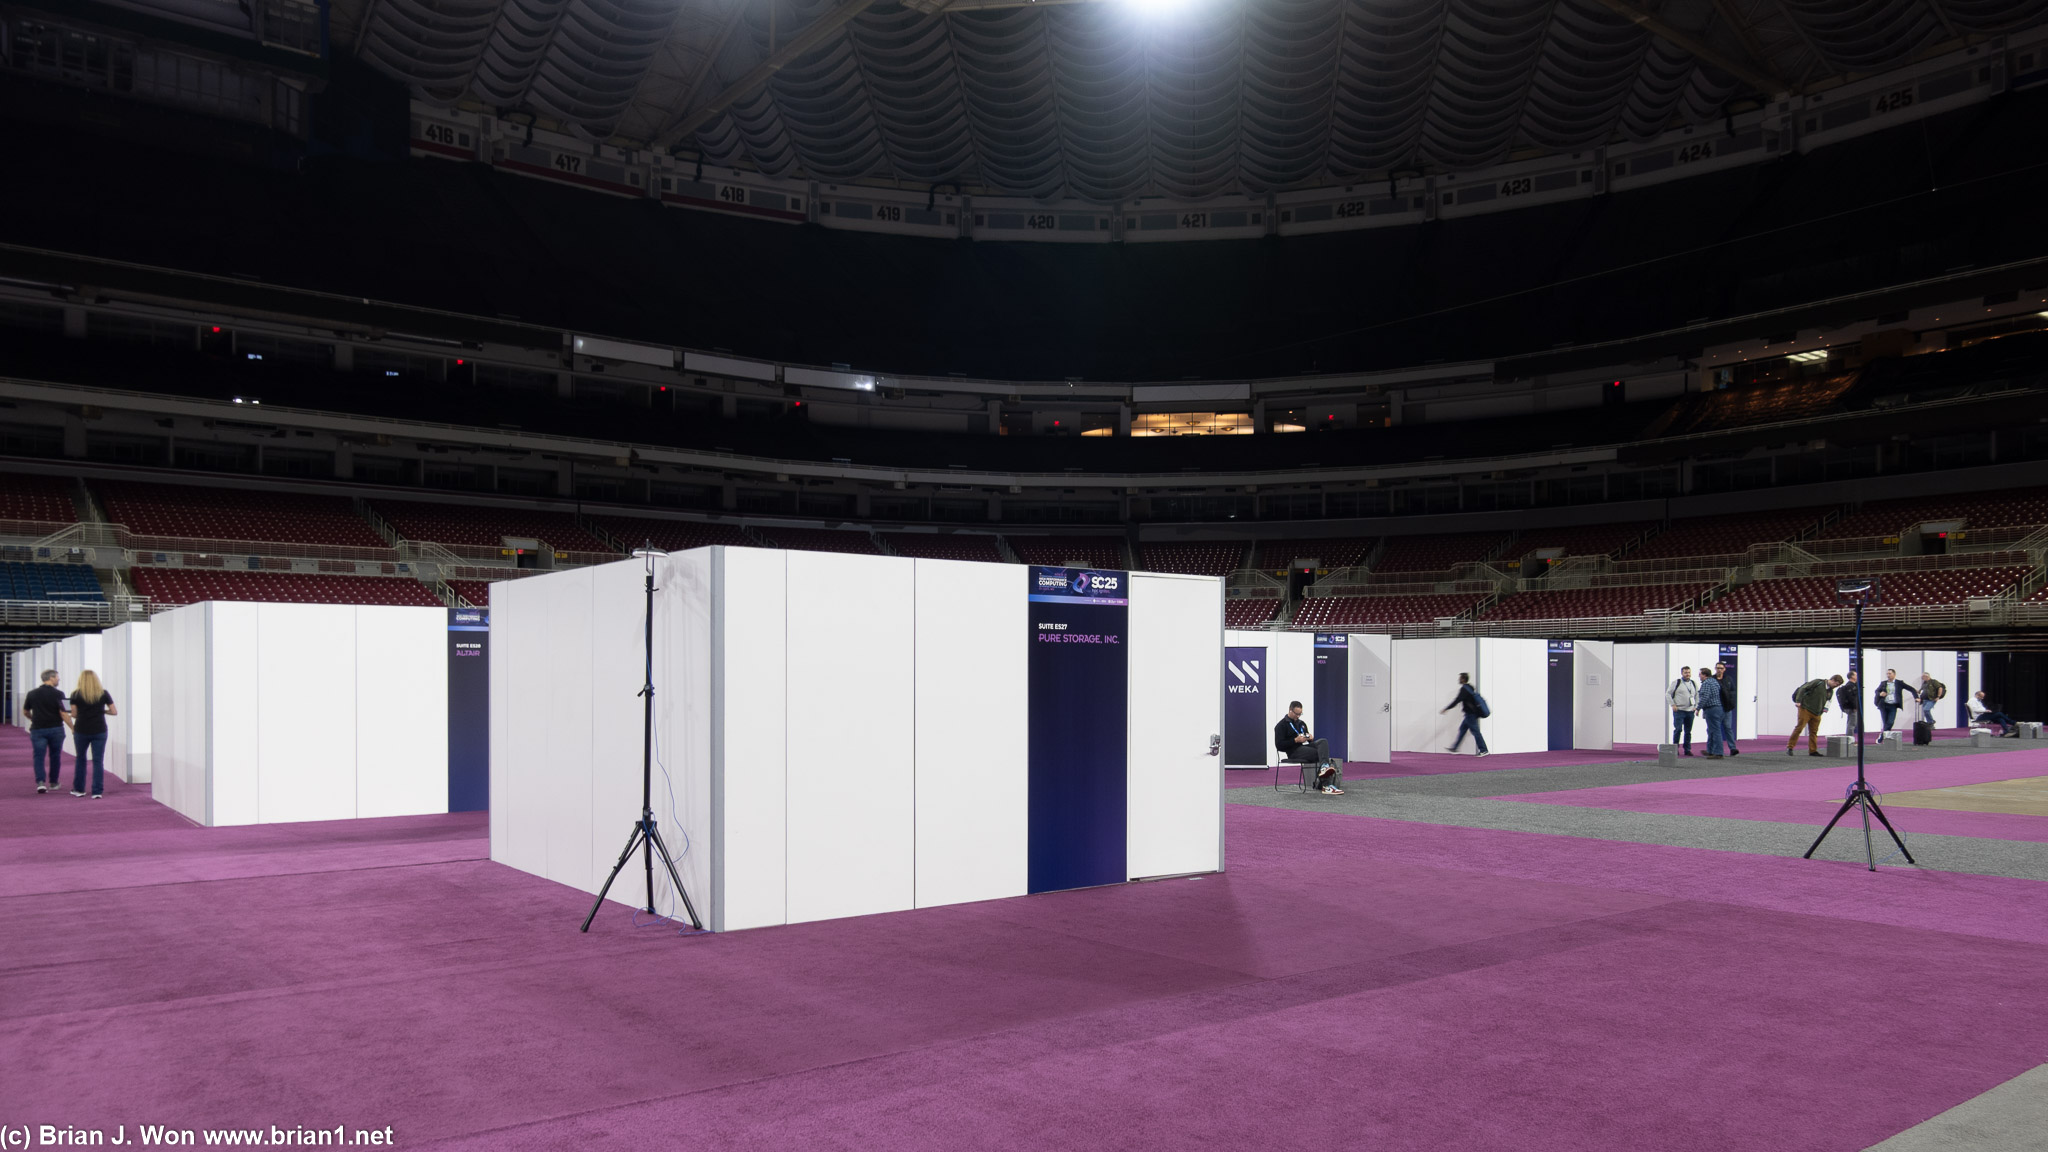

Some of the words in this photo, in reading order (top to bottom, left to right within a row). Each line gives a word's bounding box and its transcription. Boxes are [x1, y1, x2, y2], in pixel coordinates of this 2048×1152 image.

[1876, 89, 1913, 112] 425
[426, 124, 454, 144] 416
[1679, 142, 1712, 163] 424
[555, 154, 580, 173] 417
[721, 186, 745, 203] 418
[1501, 178, 1531, 196] 423
[877, 206, 901, 222] 419
[1337, 201, 1364, 217] 422
[1028, 215, 1055, 229] 420
[1182, 213, 1207, 228] 421
[1091, 576, 1117, 589] SC25
[1039, 634, 1061, 642] PURE
[1063, 634, 1103, 644] STORAGE,
[1104, 635, 1120, 644] INC.
[1228, 685, 1259, 694] WEKA
